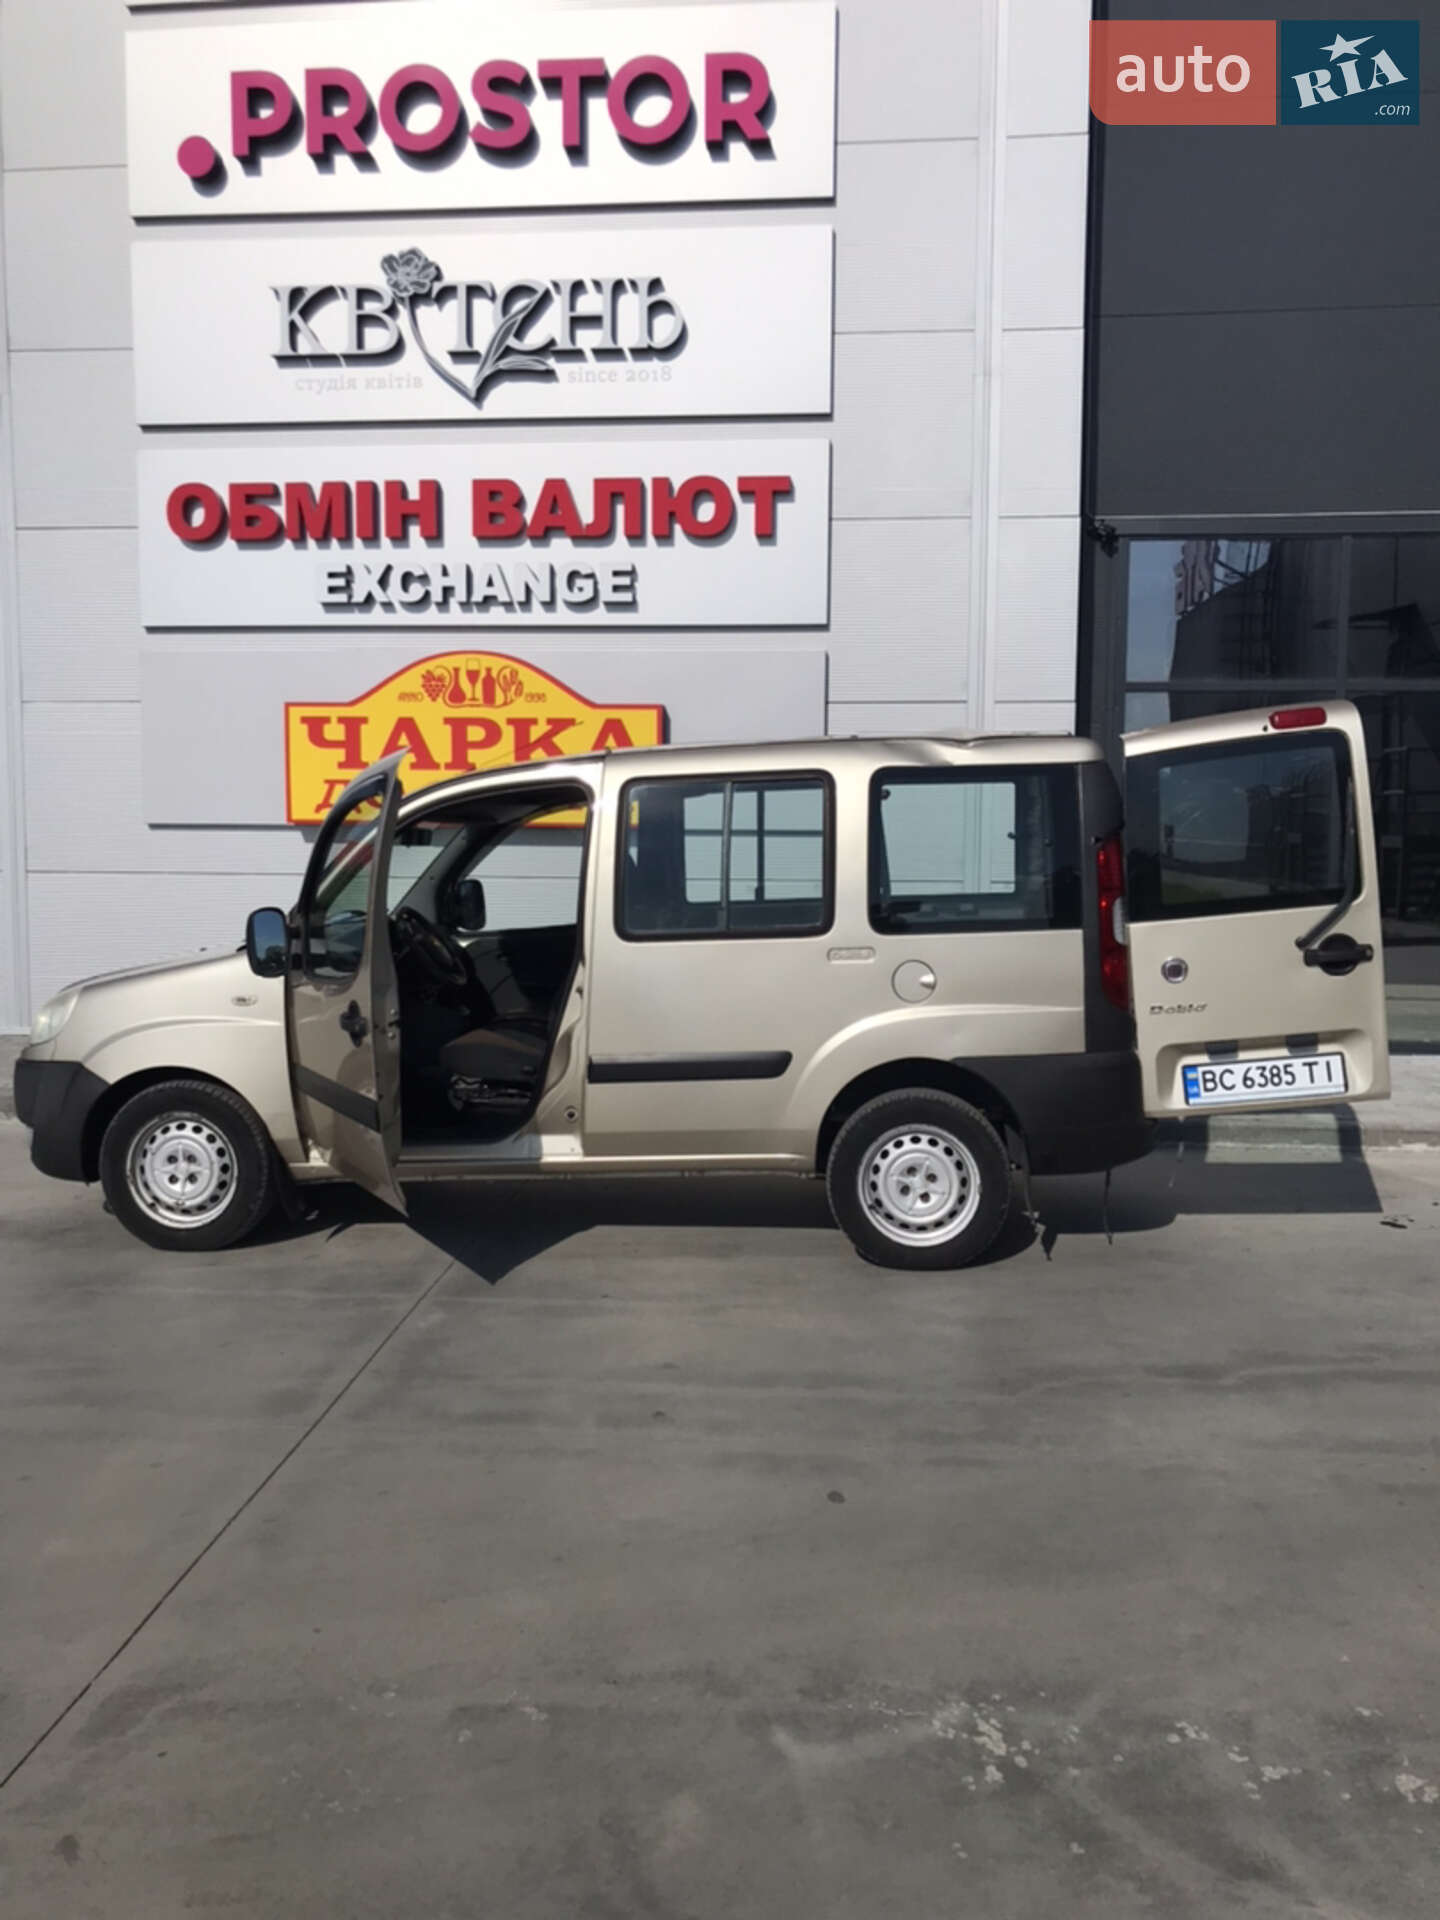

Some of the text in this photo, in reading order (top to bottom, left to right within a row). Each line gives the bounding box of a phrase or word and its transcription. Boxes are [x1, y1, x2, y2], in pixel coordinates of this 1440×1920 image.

[567, 365, 673, 384] since 2018
[166, 475, 794, 546] ОБМІН ВАЛЮТ
[321, 561, 639, 611] EXCHANGE
[1201, 1068, 1237, 1093] BC
[1242, 1062, 1297, 1089] 6385
